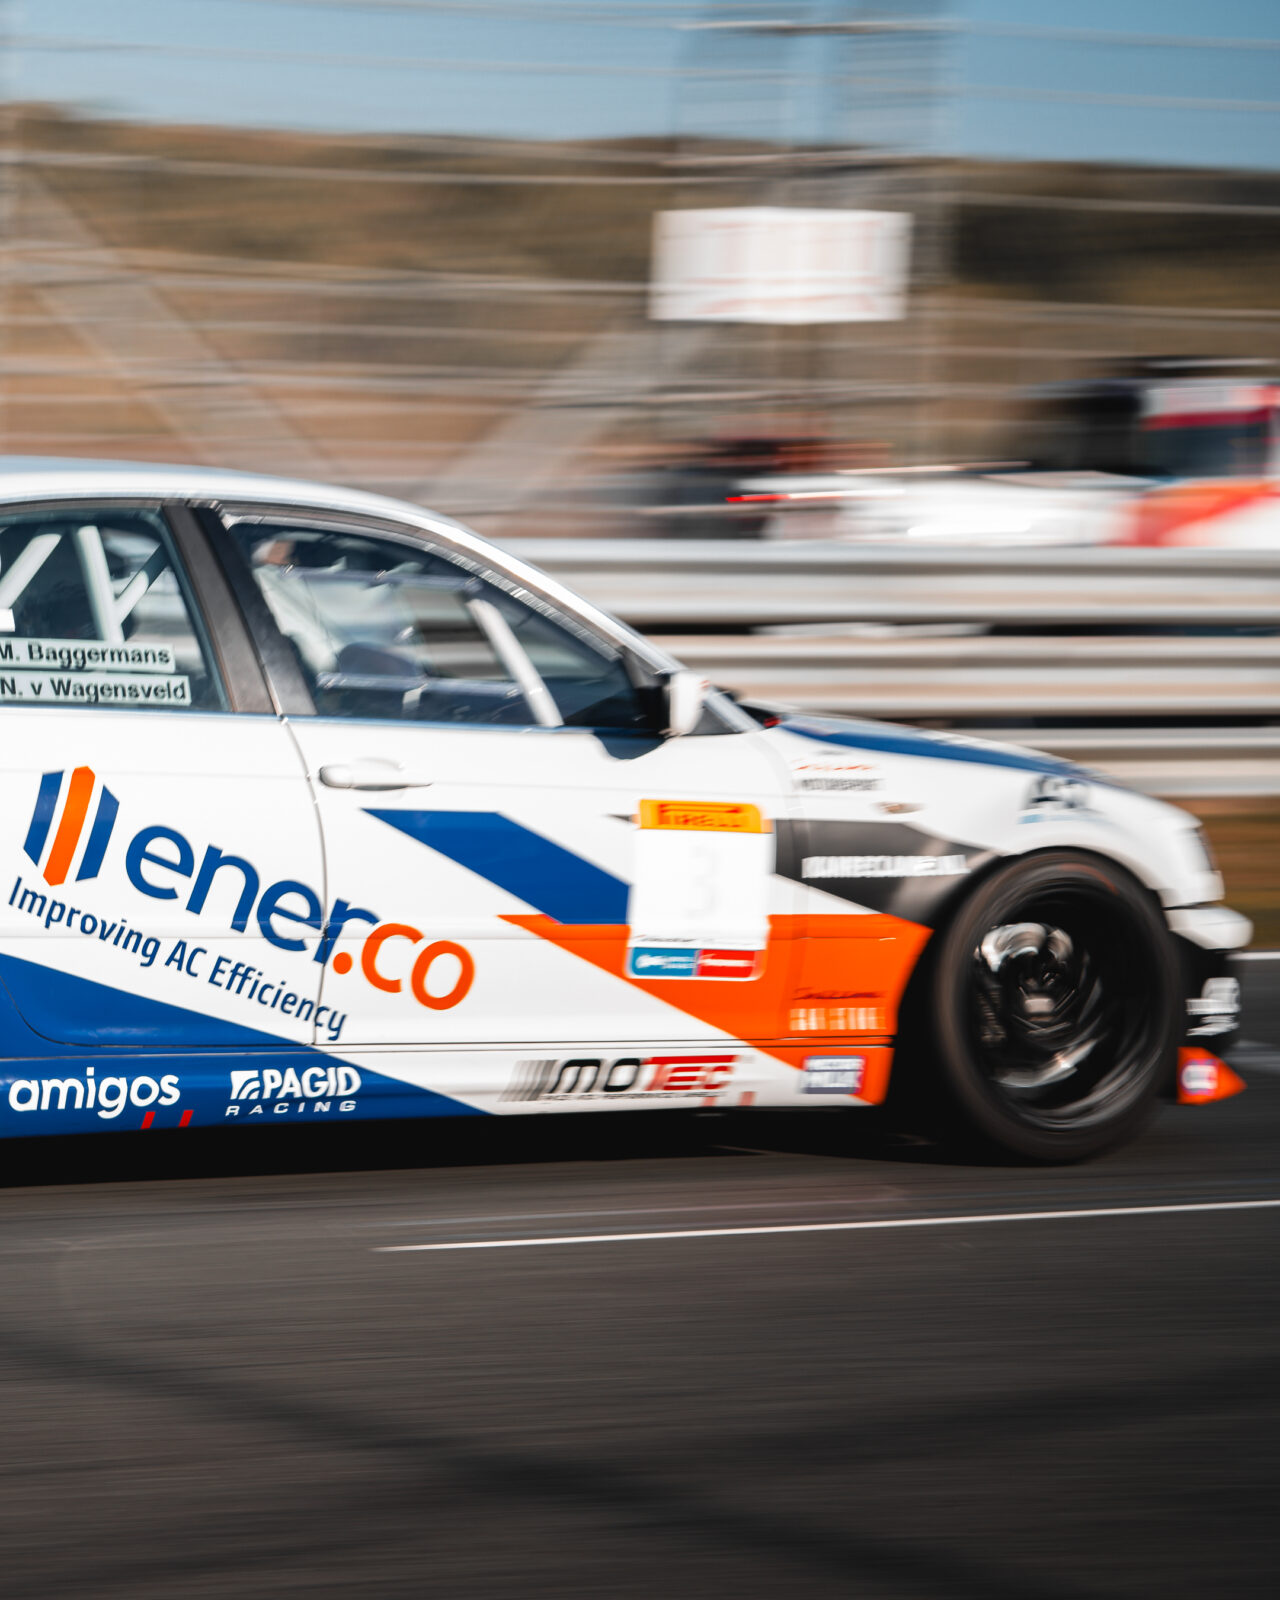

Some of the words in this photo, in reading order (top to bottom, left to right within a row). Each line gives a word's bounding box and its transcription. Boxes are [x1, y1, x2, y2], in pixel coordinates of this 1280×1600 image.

[28, 643, 172, 669] Baggermans
[0, 676, 23, 696] N.
[30, 681, 43, 696] v
[50, 678, 187, 703] Wagensveld
[125, 825, 475, 1011] ener.co
[8, 876, 157, 968] Improving
[165, 939, 202, 978] AC
[207, 956, 348, 1042] Efficiency
[8, 1067, 181, 1119] amigos
[262, 1066, 362, 1099] PAGID
[224, 1100, 358, 1117] RACING
